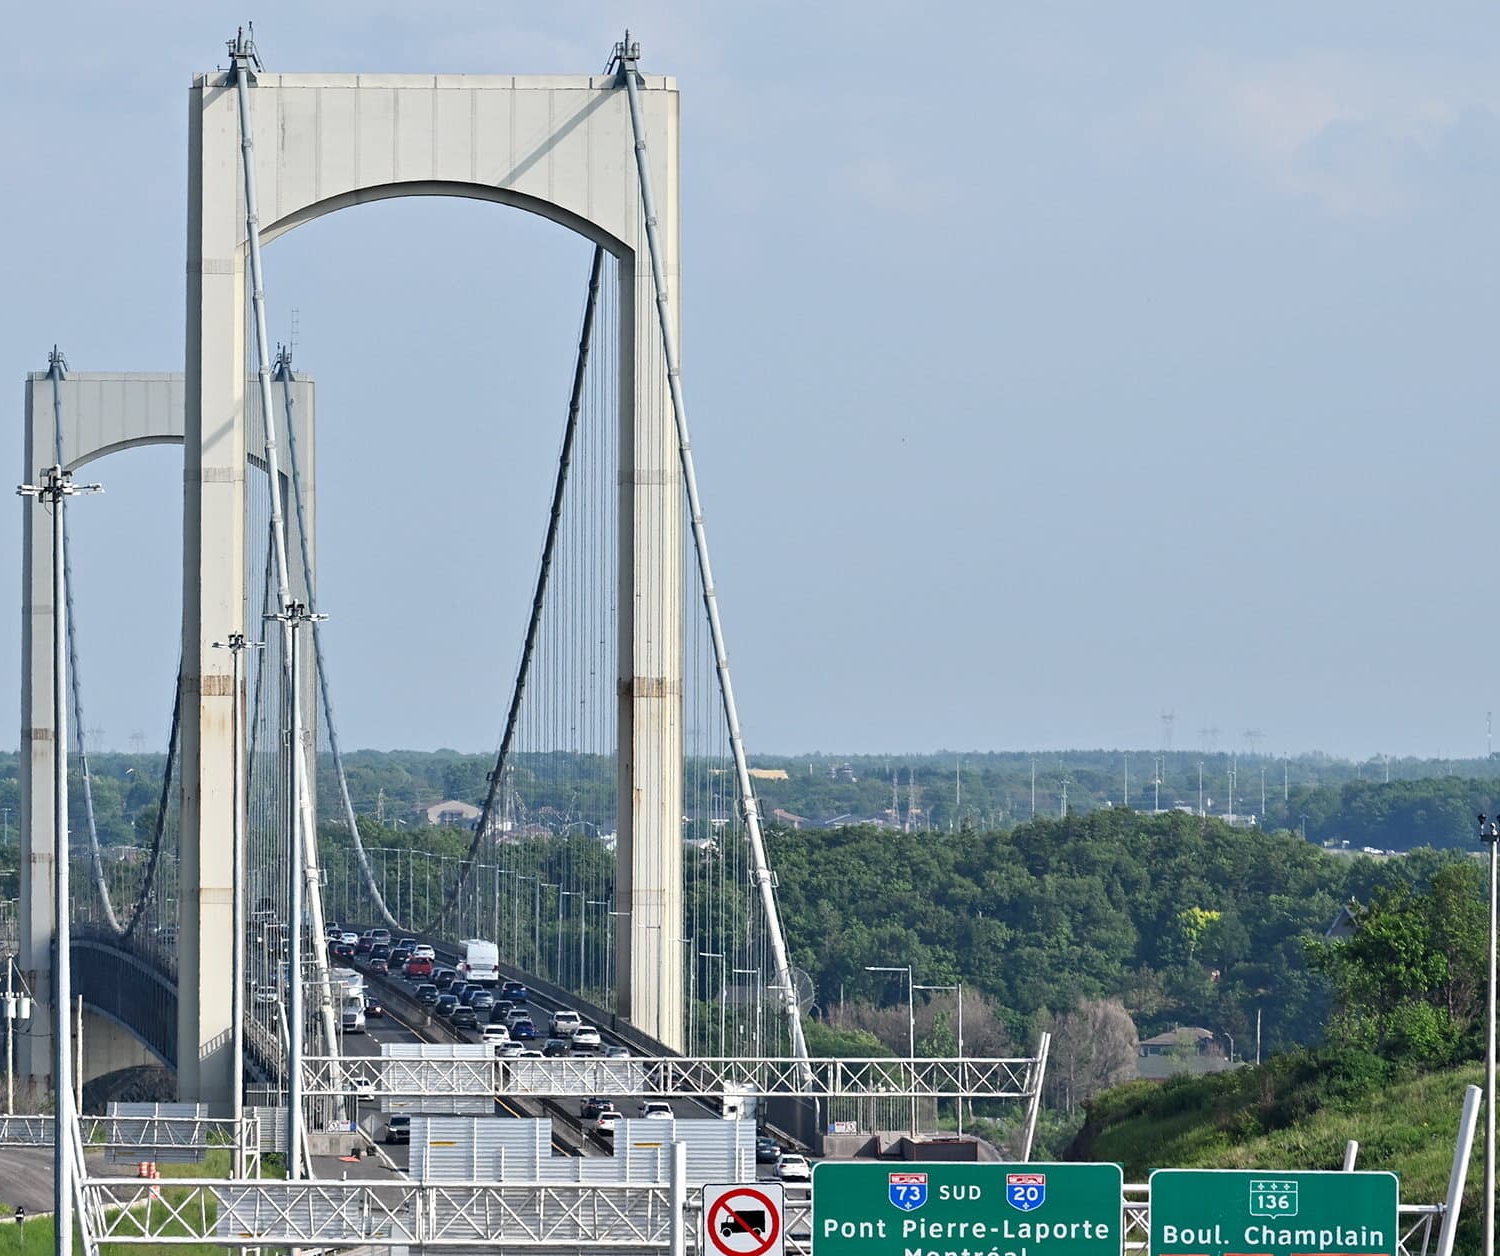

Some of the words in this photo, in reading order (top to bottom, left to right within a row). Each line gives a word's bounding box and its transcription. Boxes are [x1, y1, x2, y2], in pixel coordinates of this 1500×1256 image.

[896, 1186, 921, 1201] 73
[939, 1185, 982, 1200] SUD
[1013, 1186, 1039, 1201] 20
[1257, 1194, 1290, 1209] 136
[824, 1219, 887, 1238] Pont
[902, 1218, 1109, 1243] Pierre-Laporte
[1163, 1224, 1230, 1245] Boul.
[1244, 1225, 1384, 1250] Champlain
